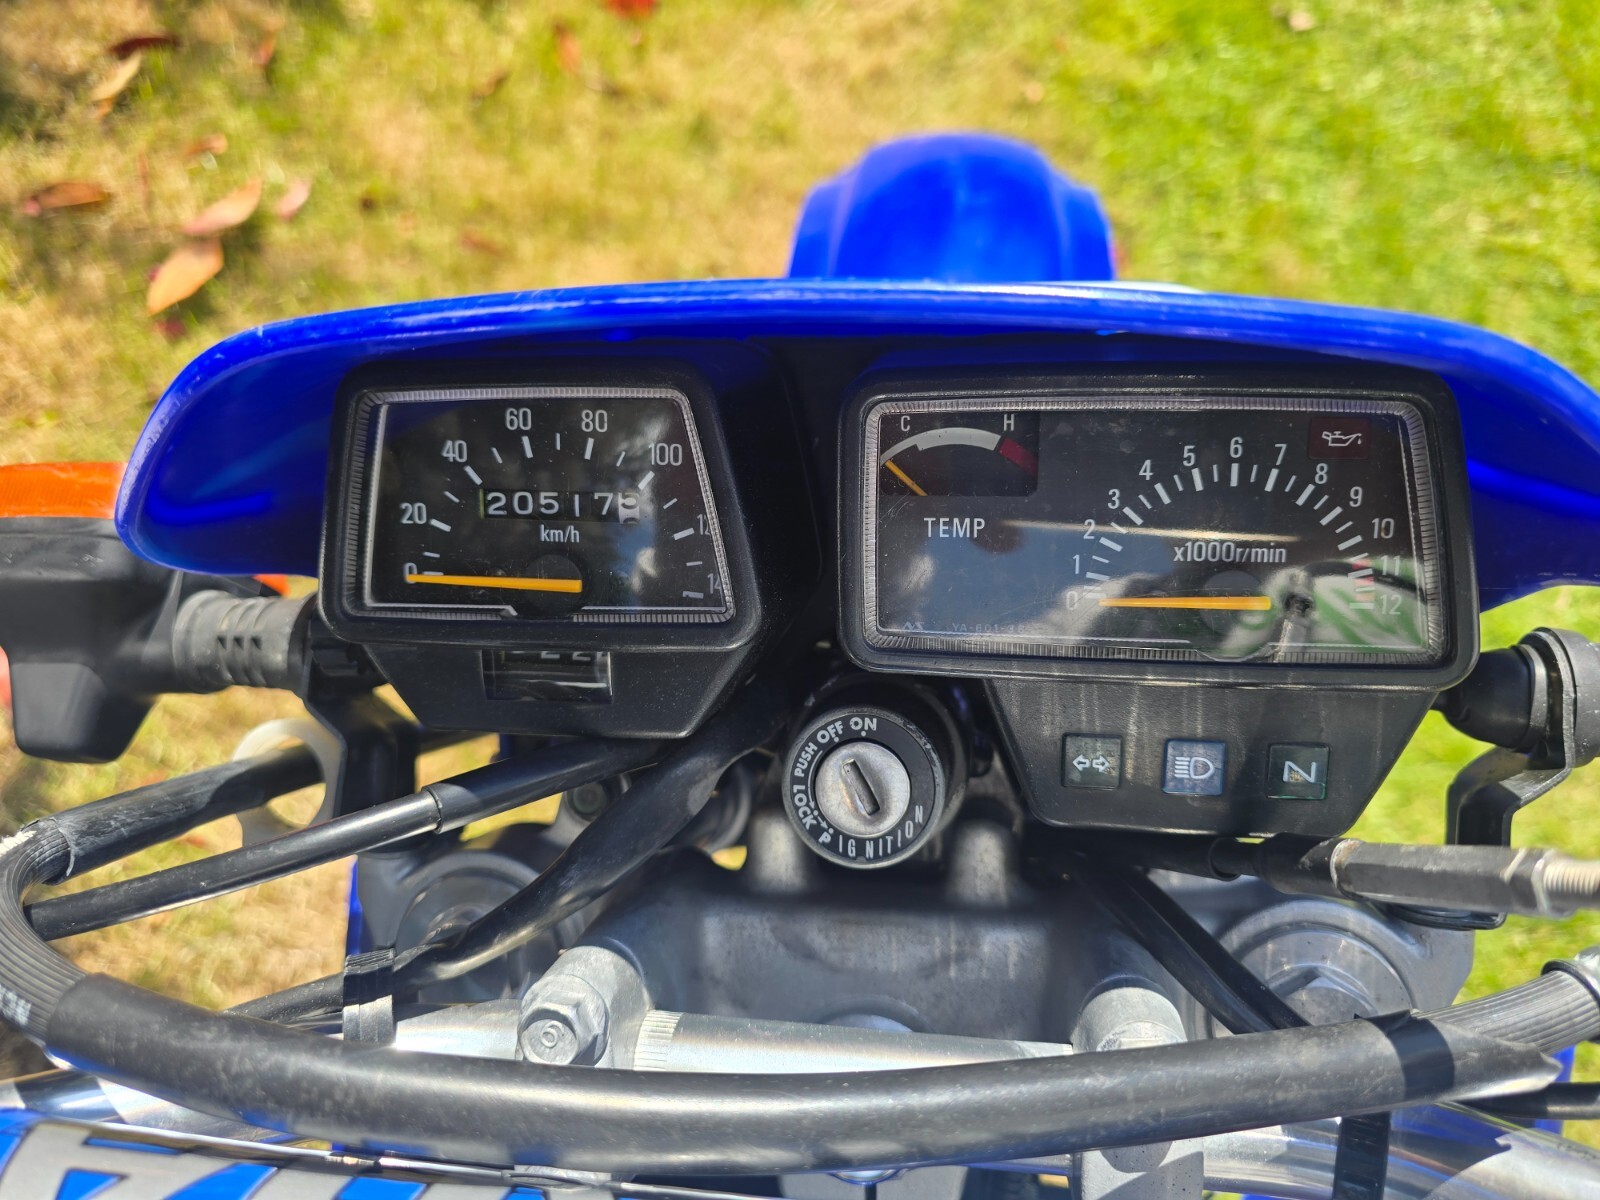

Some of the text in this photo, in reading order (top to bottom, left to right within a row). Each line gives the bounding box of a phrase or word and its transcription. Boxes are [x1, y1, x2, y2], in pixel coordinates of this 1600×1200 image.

[505, 407, 532, 431] 60
[581, 409, 608, 433] 80
[900, 415, 911, 432] C
[1003, 414, 1015, 431] H
[441, 439, 468, 463] 40
[648, 443, 683, 467] 100
[1182, 445, 1196, 467] 5
[1229, 436, 1243, 458] 6
[1274, 443, 1287, 466] 7
[1139, 459, 1153, 480] 4
[1315, 463, 1328, 485] 8
[1107, 488, 1121, 509] 3
[1349, 486, 1363, 508] 9
[400, 502, 427, 525] 20
[540, 524, 580, 543] km/h
[923, 517, 986, 538] TEMP
[1083, 519, 1096, 540] 2
[1371, 517, 1395, 539] 10
[1173, 541, 1287, 563] x1000r/min
[1072, 554, 1081, 575] 1
[1379, 555, 1401, 576] 11
[1065, 590, 1078, 611] 0
[1379, 594, 1401, 616] 12
[816, 720, 844, 744] OFF
[849, 717, 878, 732] ON
[794, 742, 818, 778] PUSH
[1283, 760, 1317, 784] N
[792, 784, 818, 831] LOCK
[818, 831, 832, 844] P
[838, 805, 924, 860] IGNITION
